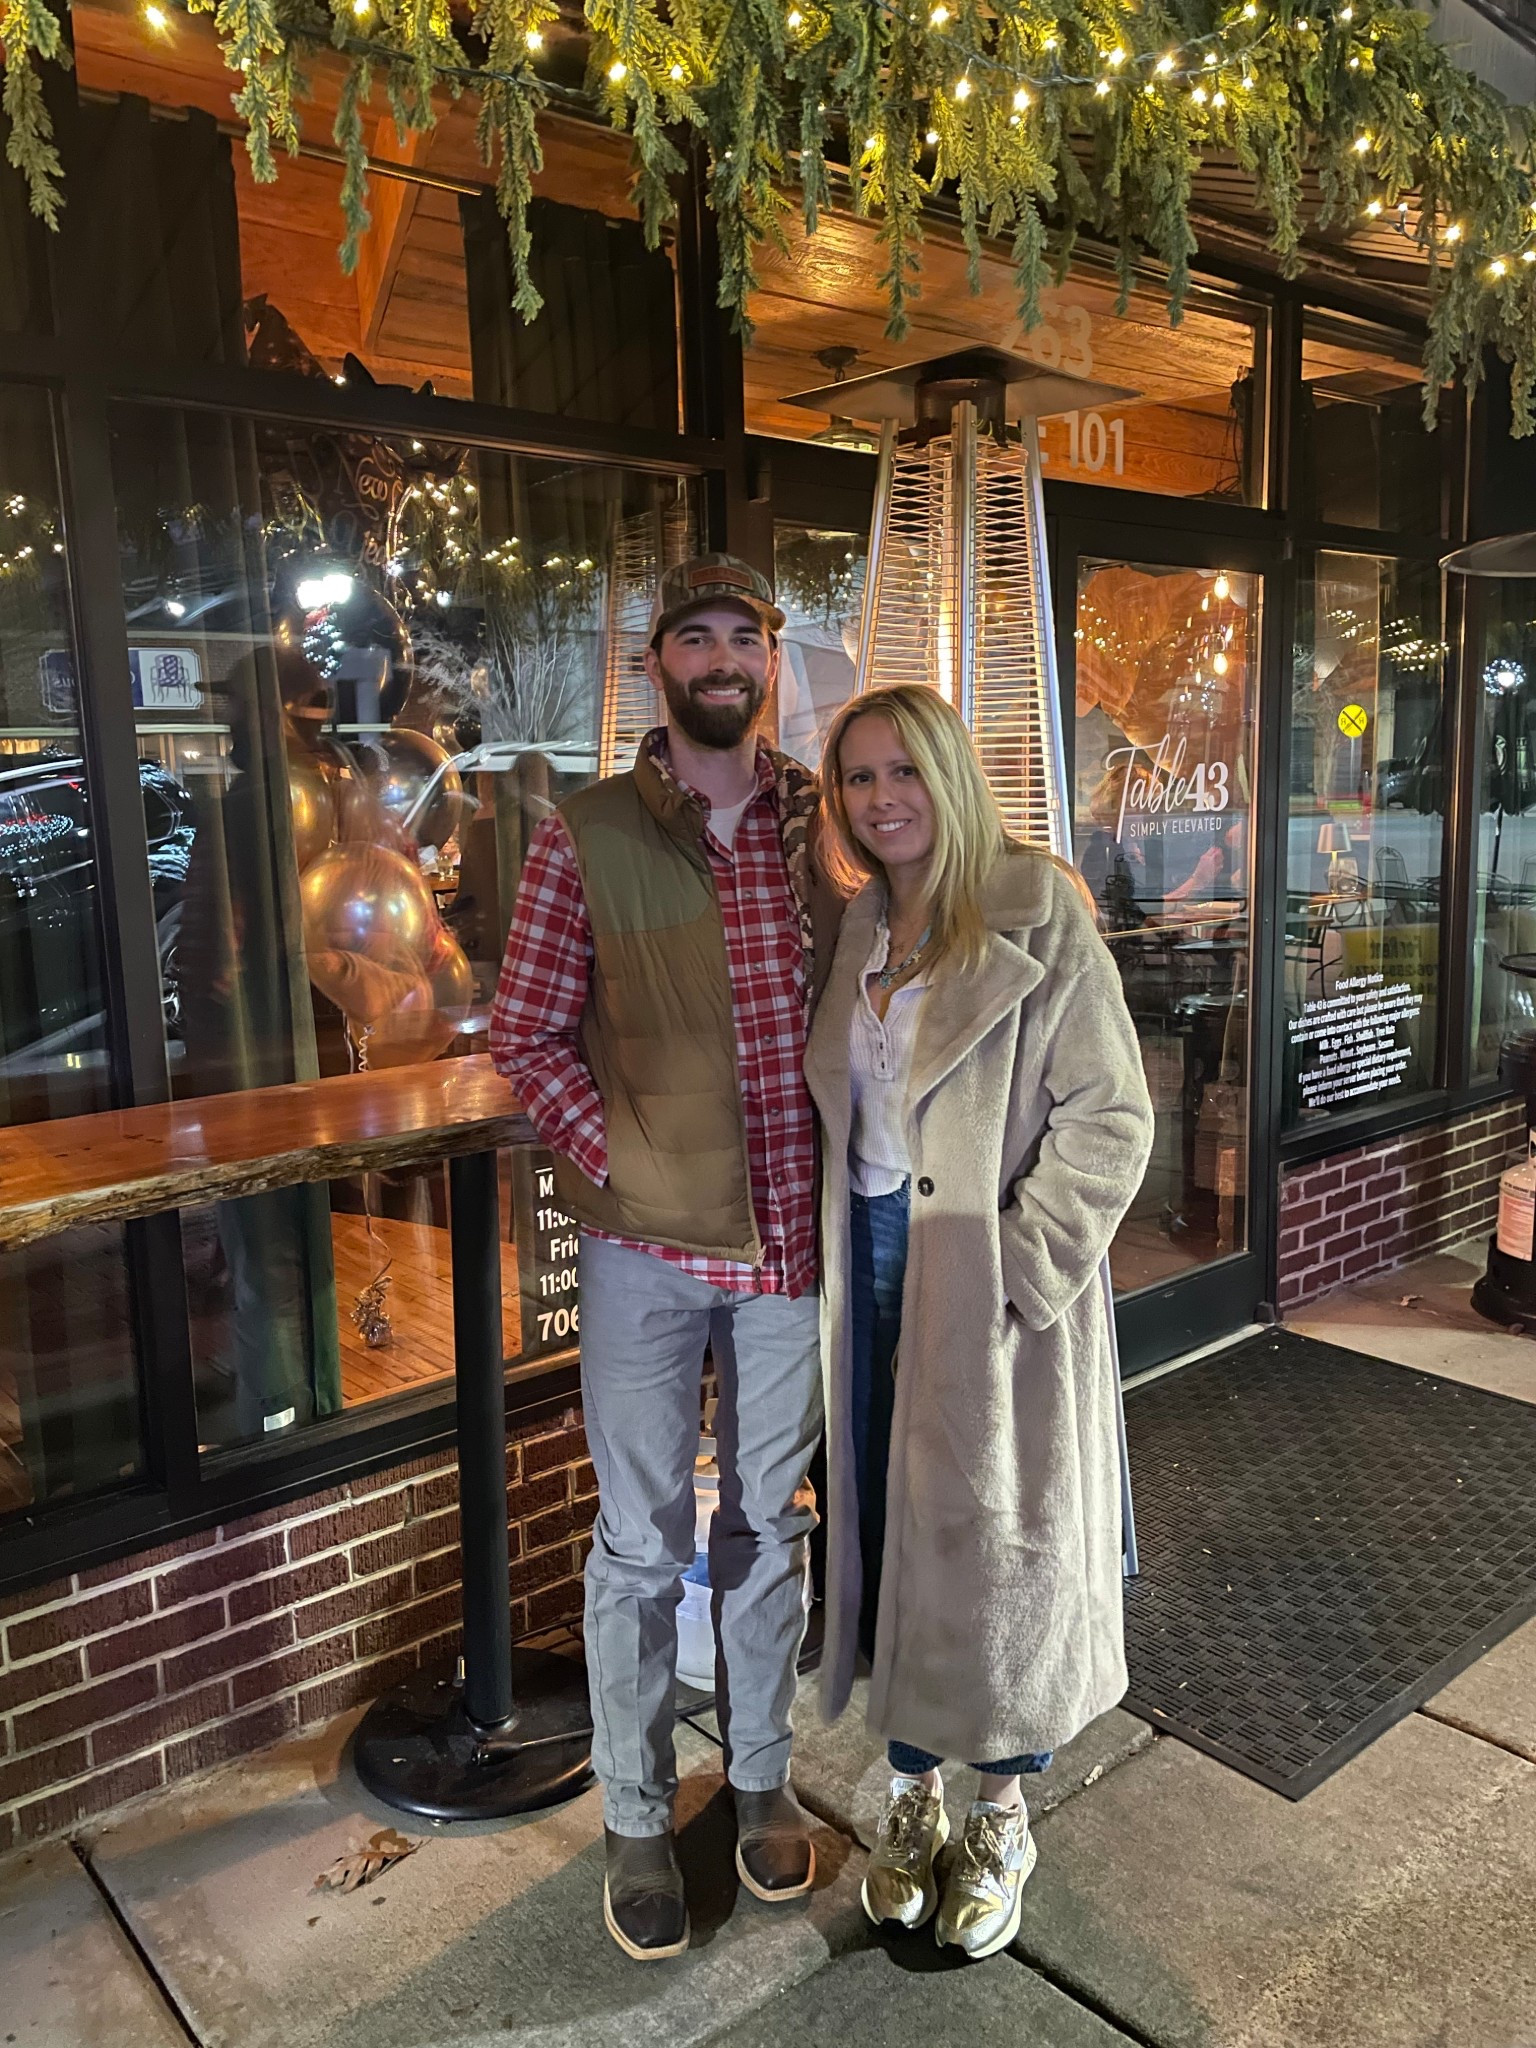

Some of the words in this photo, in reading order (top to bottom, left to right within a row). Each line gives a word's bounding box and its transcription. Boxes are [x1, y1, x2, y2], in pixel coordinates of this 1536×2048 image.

[1064, 411, 1124, 475] 101
[1130, 821, 1170, 838] SIMPLY
[1172, 817, 1222, 835] ELEVATED
[1335, 980, 1349, 991] Food
[1349, 977, 1367, 988] Allergy
[1367, 972, 1384, 984] Notice
[1304, 1001, 1317, 1013] Table
